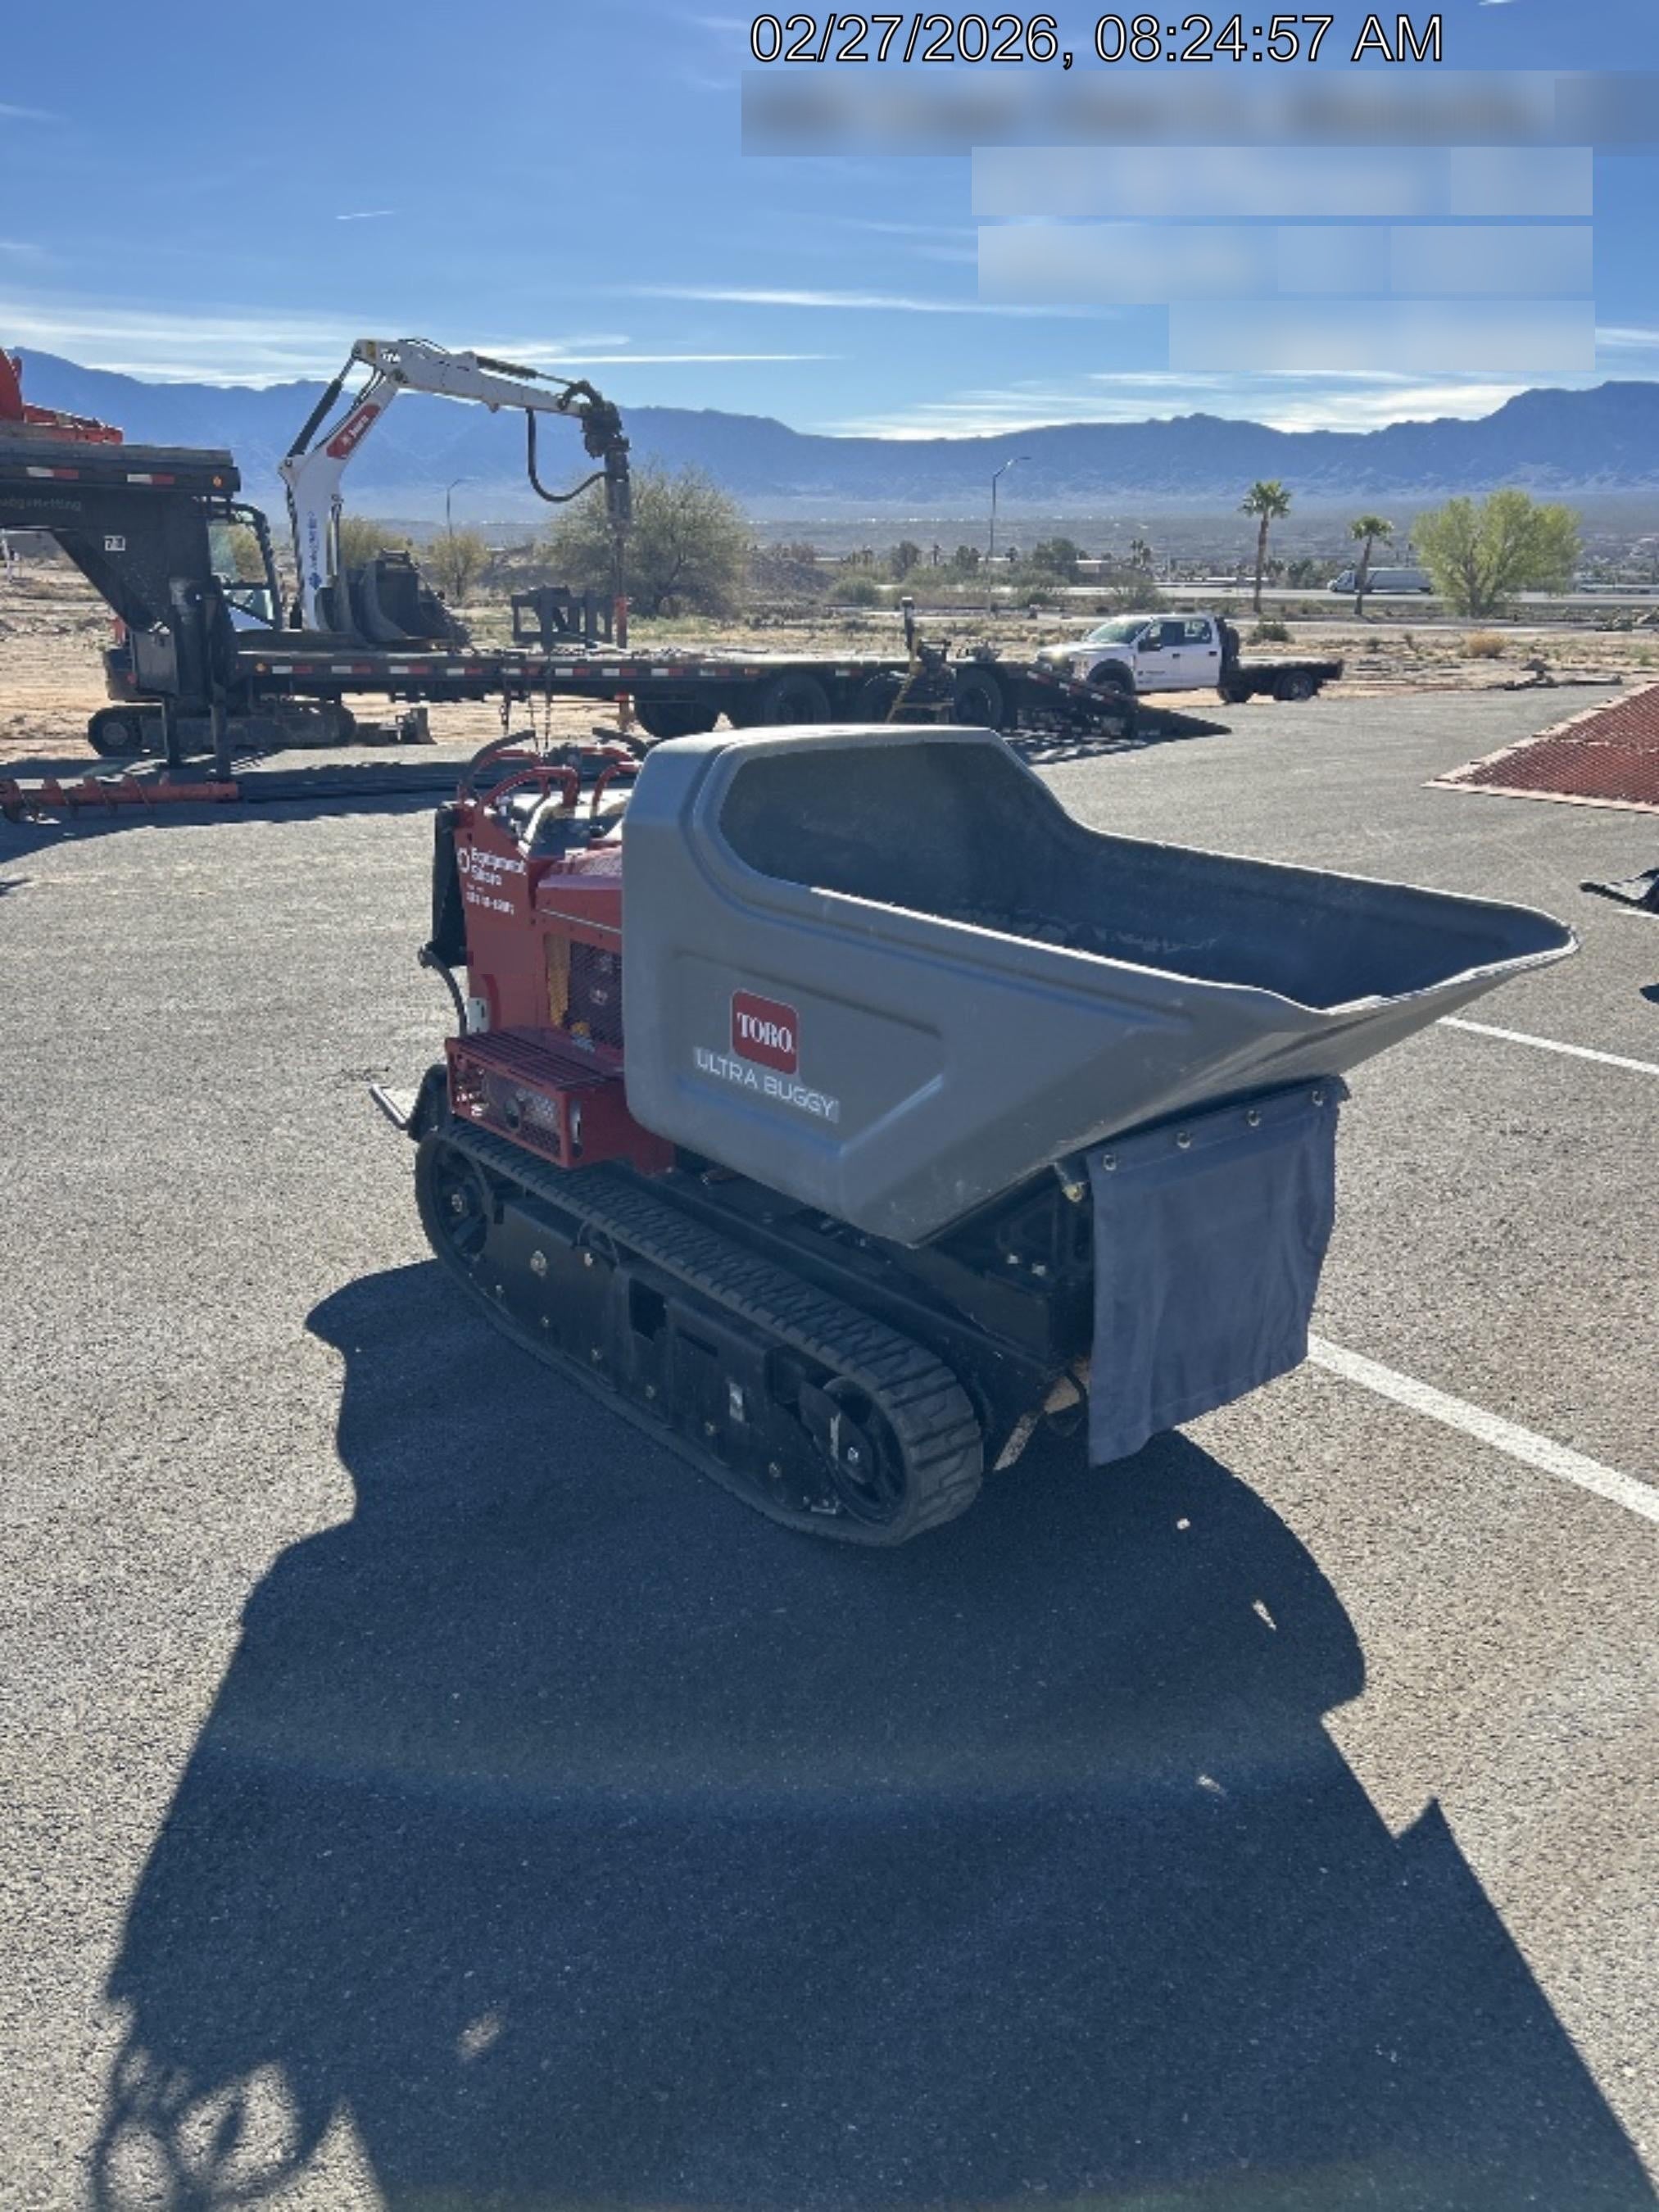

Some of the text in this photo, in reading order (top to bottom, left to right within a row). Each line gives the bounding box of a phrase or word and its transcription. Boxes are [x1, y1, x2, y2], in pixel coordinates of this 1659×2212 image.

[737, 1012, 793, 1054] TORO
[696, 1048, 836, 1117] ULTRA BUGGY
